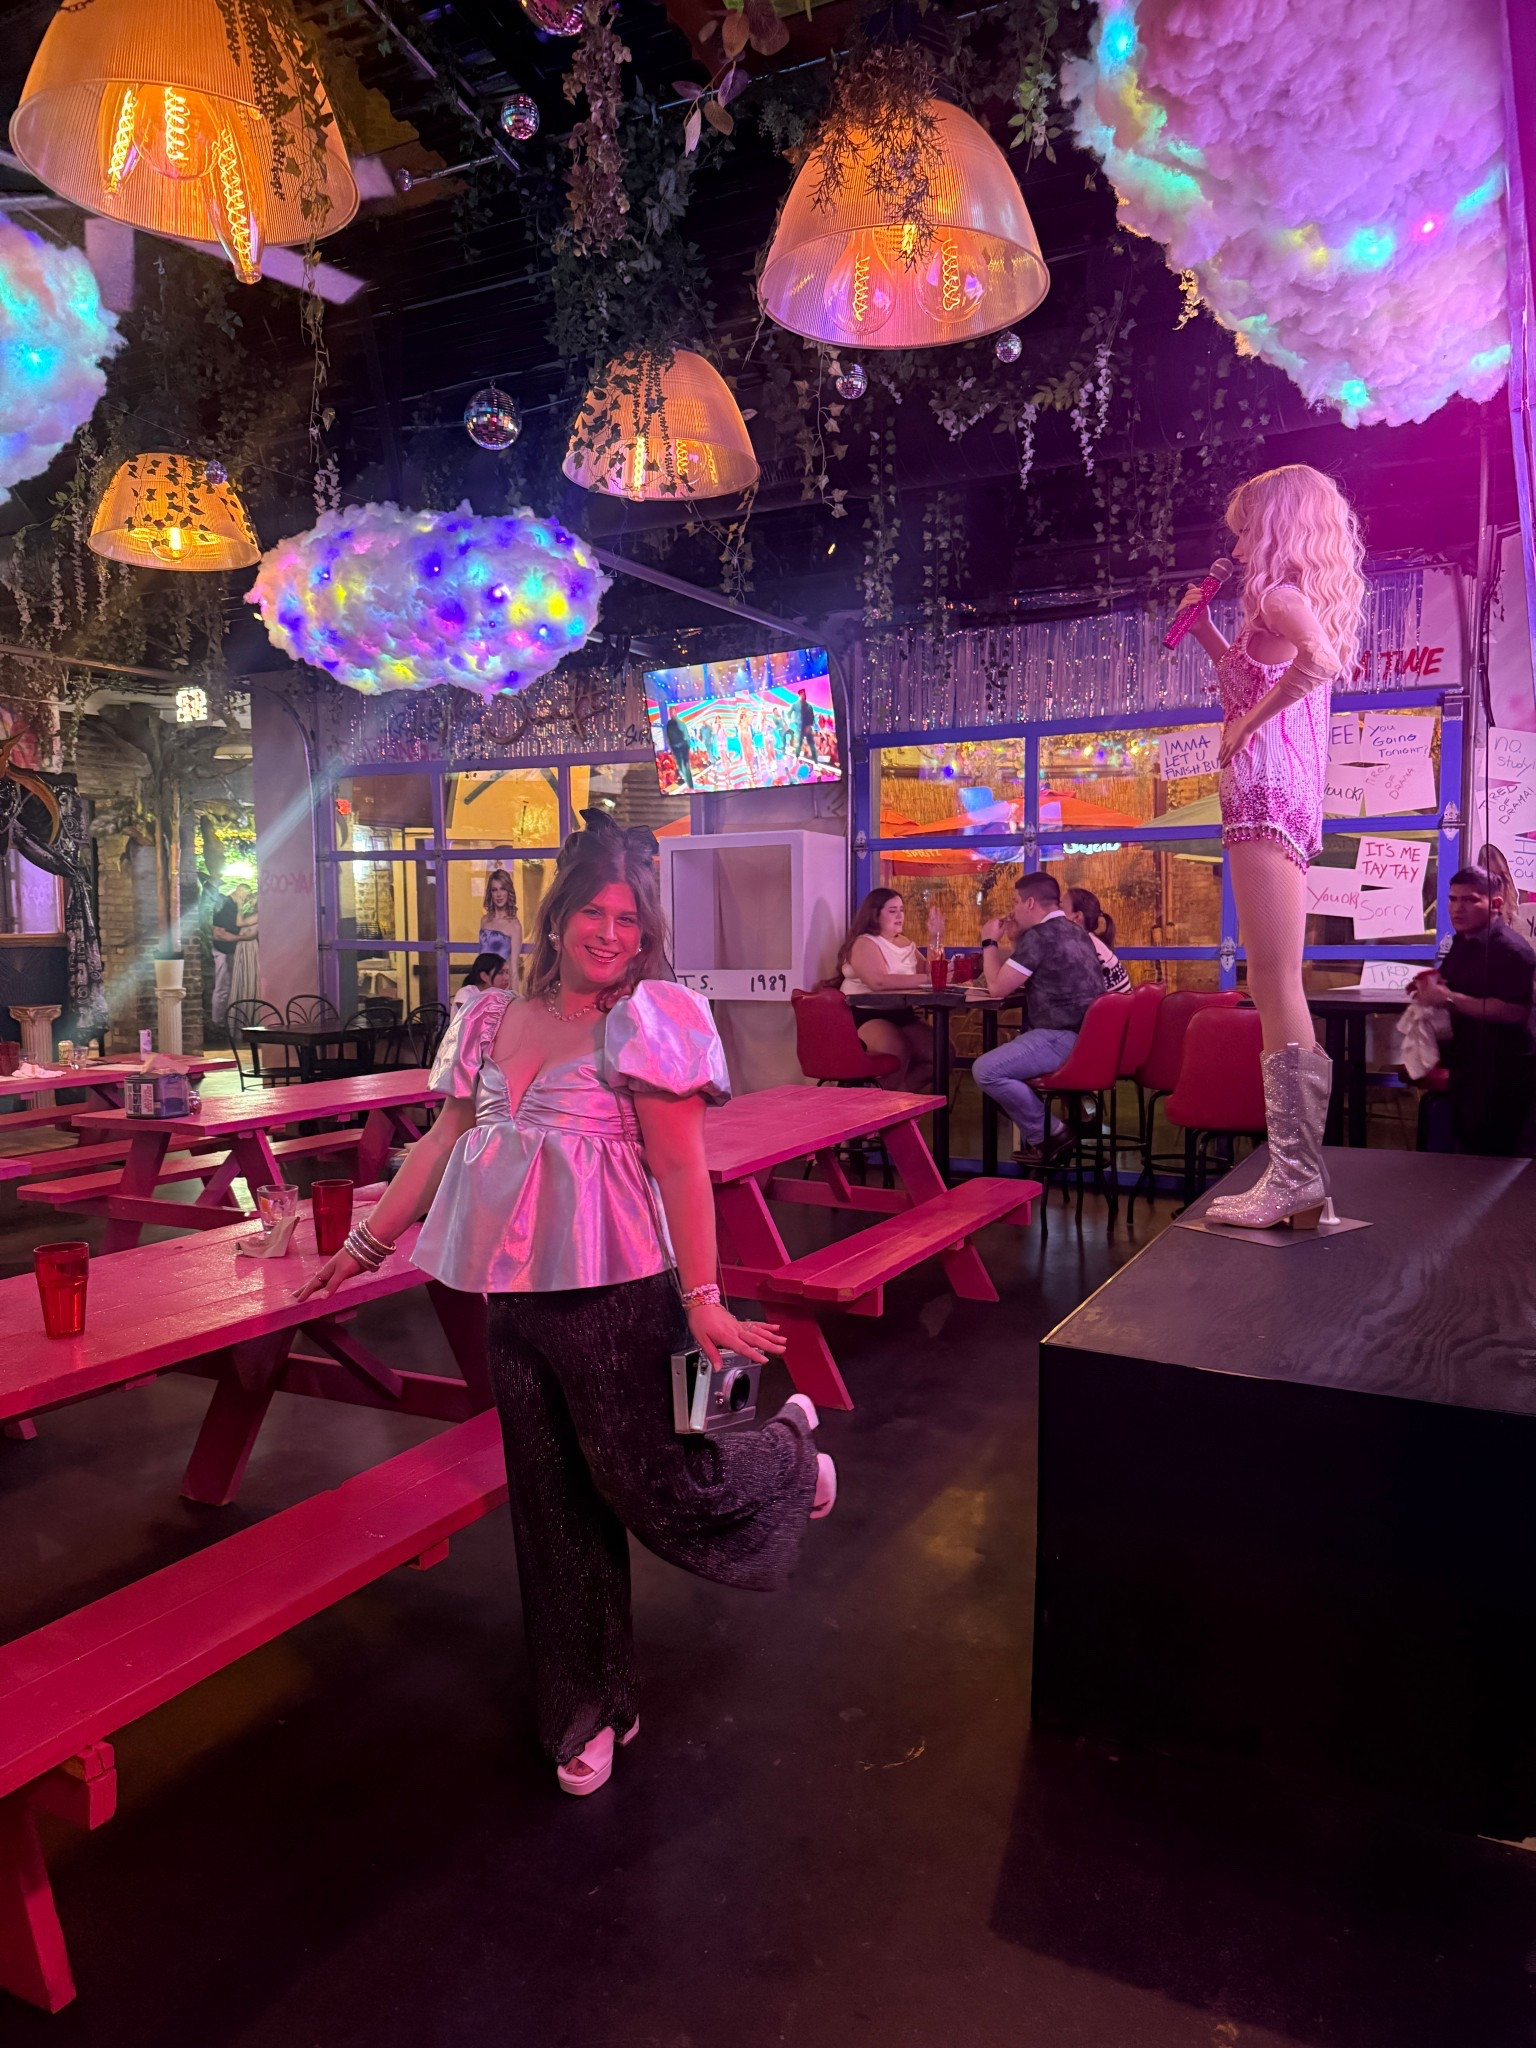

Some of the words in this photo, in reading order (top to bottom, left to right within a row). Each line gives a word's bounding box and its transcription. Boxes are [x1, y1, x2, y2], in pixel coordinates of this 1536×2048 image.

[1164, 735, 1211, 756] IMMA
[1165, 753, 1189, 768] LET
[1196, 750, 1206, 761] U
[1164, 764, 1201, 780] FINISH
[1384, 774, 1396, 789] OF
[1498, 798, 1510, 812] OF
[1365, 842, 1395, 858] IT'S
[1400, 847, 1421, 862] ME
[1362, 860, 1388, 879] TAY
[1389, 864, 1420, 883] TAY
[1306, 886, 1339, 911] You
[1358, 899, 1415, 921] Sorry
[750, 974, 787, 992] 1989
